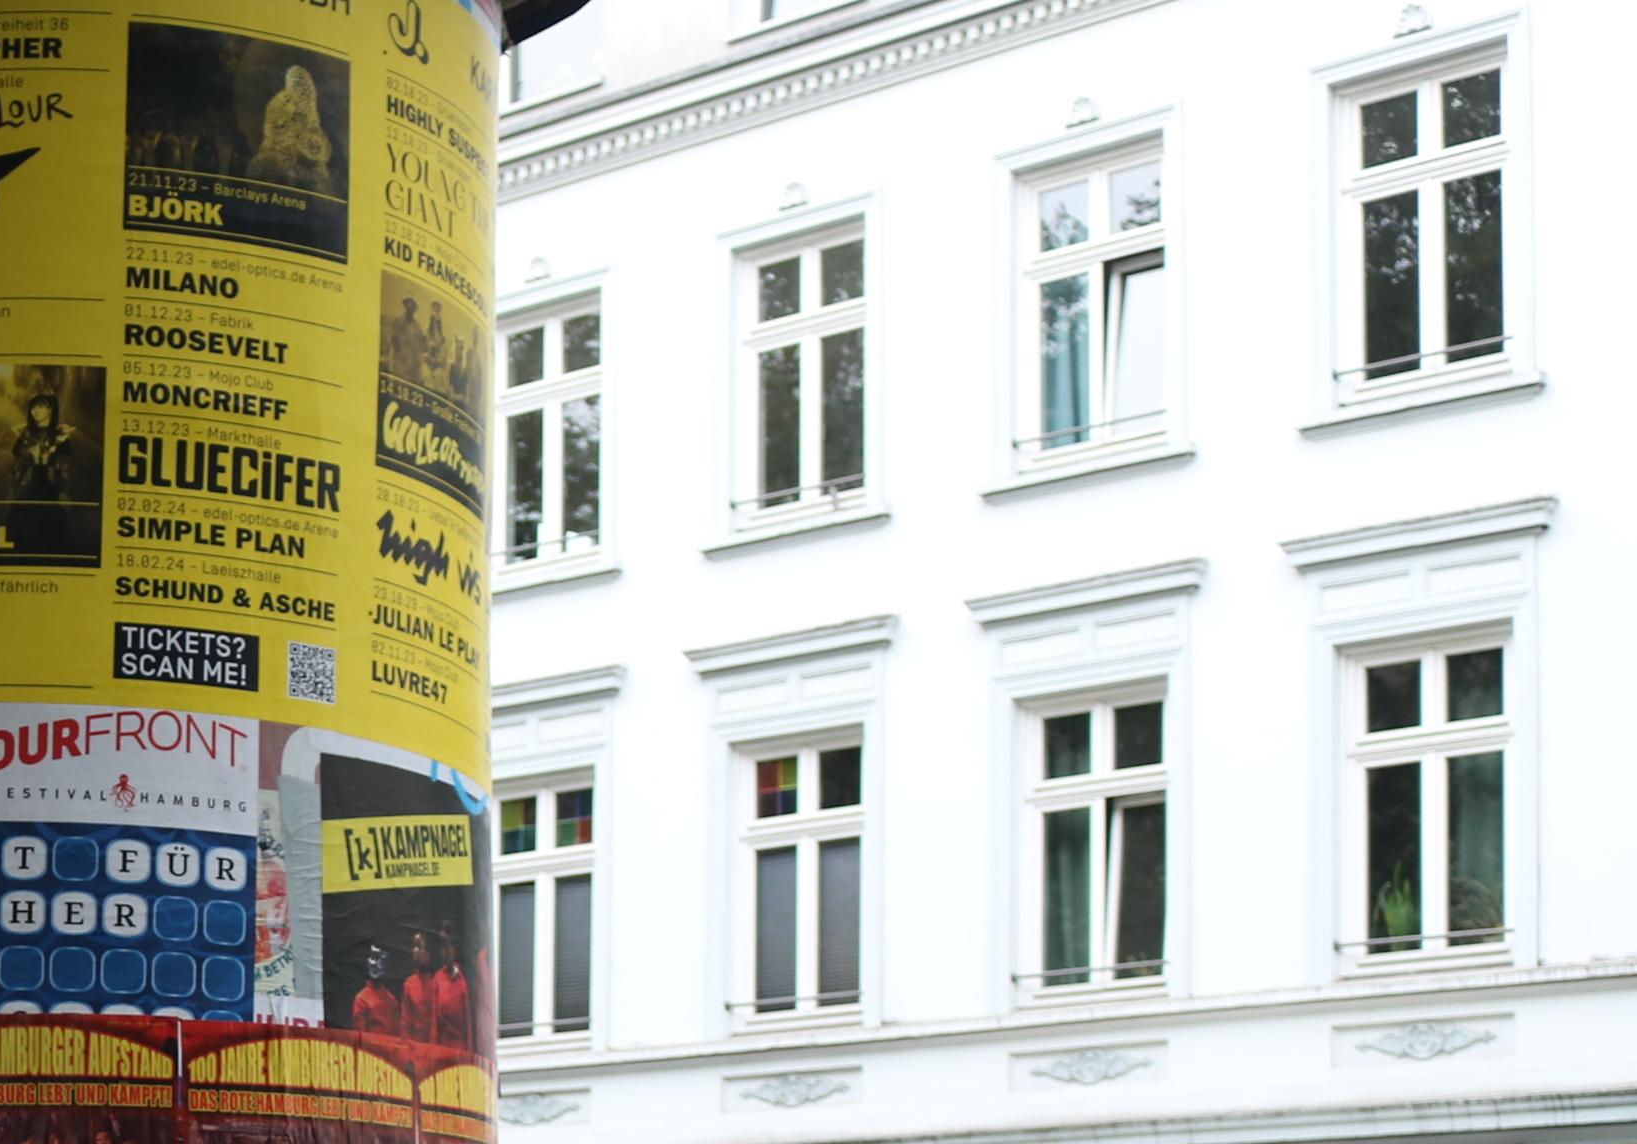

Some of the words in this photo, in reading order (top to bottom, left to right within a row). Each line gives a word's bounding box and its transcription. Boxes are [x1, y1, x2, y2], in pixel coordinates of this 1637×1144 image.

[386, 94, 444, 138] HIGHLY
[129, 172, 197, 192] 21.11.23
[213, 182, 269, 204] Barclays
[271, 192, 307, 211] Arena
[386, 142, 466, 213] YOUNG
[128, 190, 224, 226] BJÖRK
[385, 178, 457, 239] GIANT
[384, 236, 413, 263] KID
[126, 247, 194, 266] 22.11.23
[211, 257, 306, 284] edel-optics.de
[308, 276, 343, 293] Arena
[126, 266, 239, 299] MILANO
[124, 303, 193, 322] 01.12.23
[210, 312, 254, 330] Fabrik
[124, 323, 288, 364] ROOSEVELT
[209, 371, 241, 387] Mojo
[244, 374, 274, 391] Club
[123, 381, 289, 420] MONCRIEFF
[122, 418, 190, 437] 13.12.23
[207, 427, 282, 450] Markthalle
[117, 496, 186, 515] 02.02.24
[203, 503, 300, 531] edel-optics.de
[303, 521, 339, 538] Arena
[117, 516, 227, 546] SIMPLE
[236, 527, 305, 558] PLAN
[116, 553, 185, 570] 18.02.24
[202, 560, 282, 584] Laeiszhalle
[115, 576, 224, 604] SCHUND
[232, 587, 251, 608] &
[259, 592, 336, 622] ASCHE
[121, 625, 247, 659] TICKETS?
[373, 603, 434, 643] JULIAN
[439, 627, 454, 653] LE
[121, 653, 194, 680] SCAN
[203, 658, 247, 686] ME!
[371, 659, 448, 705] LUVRE47
[139, 792, 248, 813] HAMBURG
[381, 824, 468, 861] KAMPNAGEL
[118, 846, 236, 882] FÜR
[385, 860, 441, 879] KAMPNAGEL.DE
[88, 1031, 174, 1080] AUFSTAND
[37, 1082, 74, 1106] LEBT
[75, 1083, 108, 1107] UND
[109, 1080, 173, 1108] KÄMPFT!
